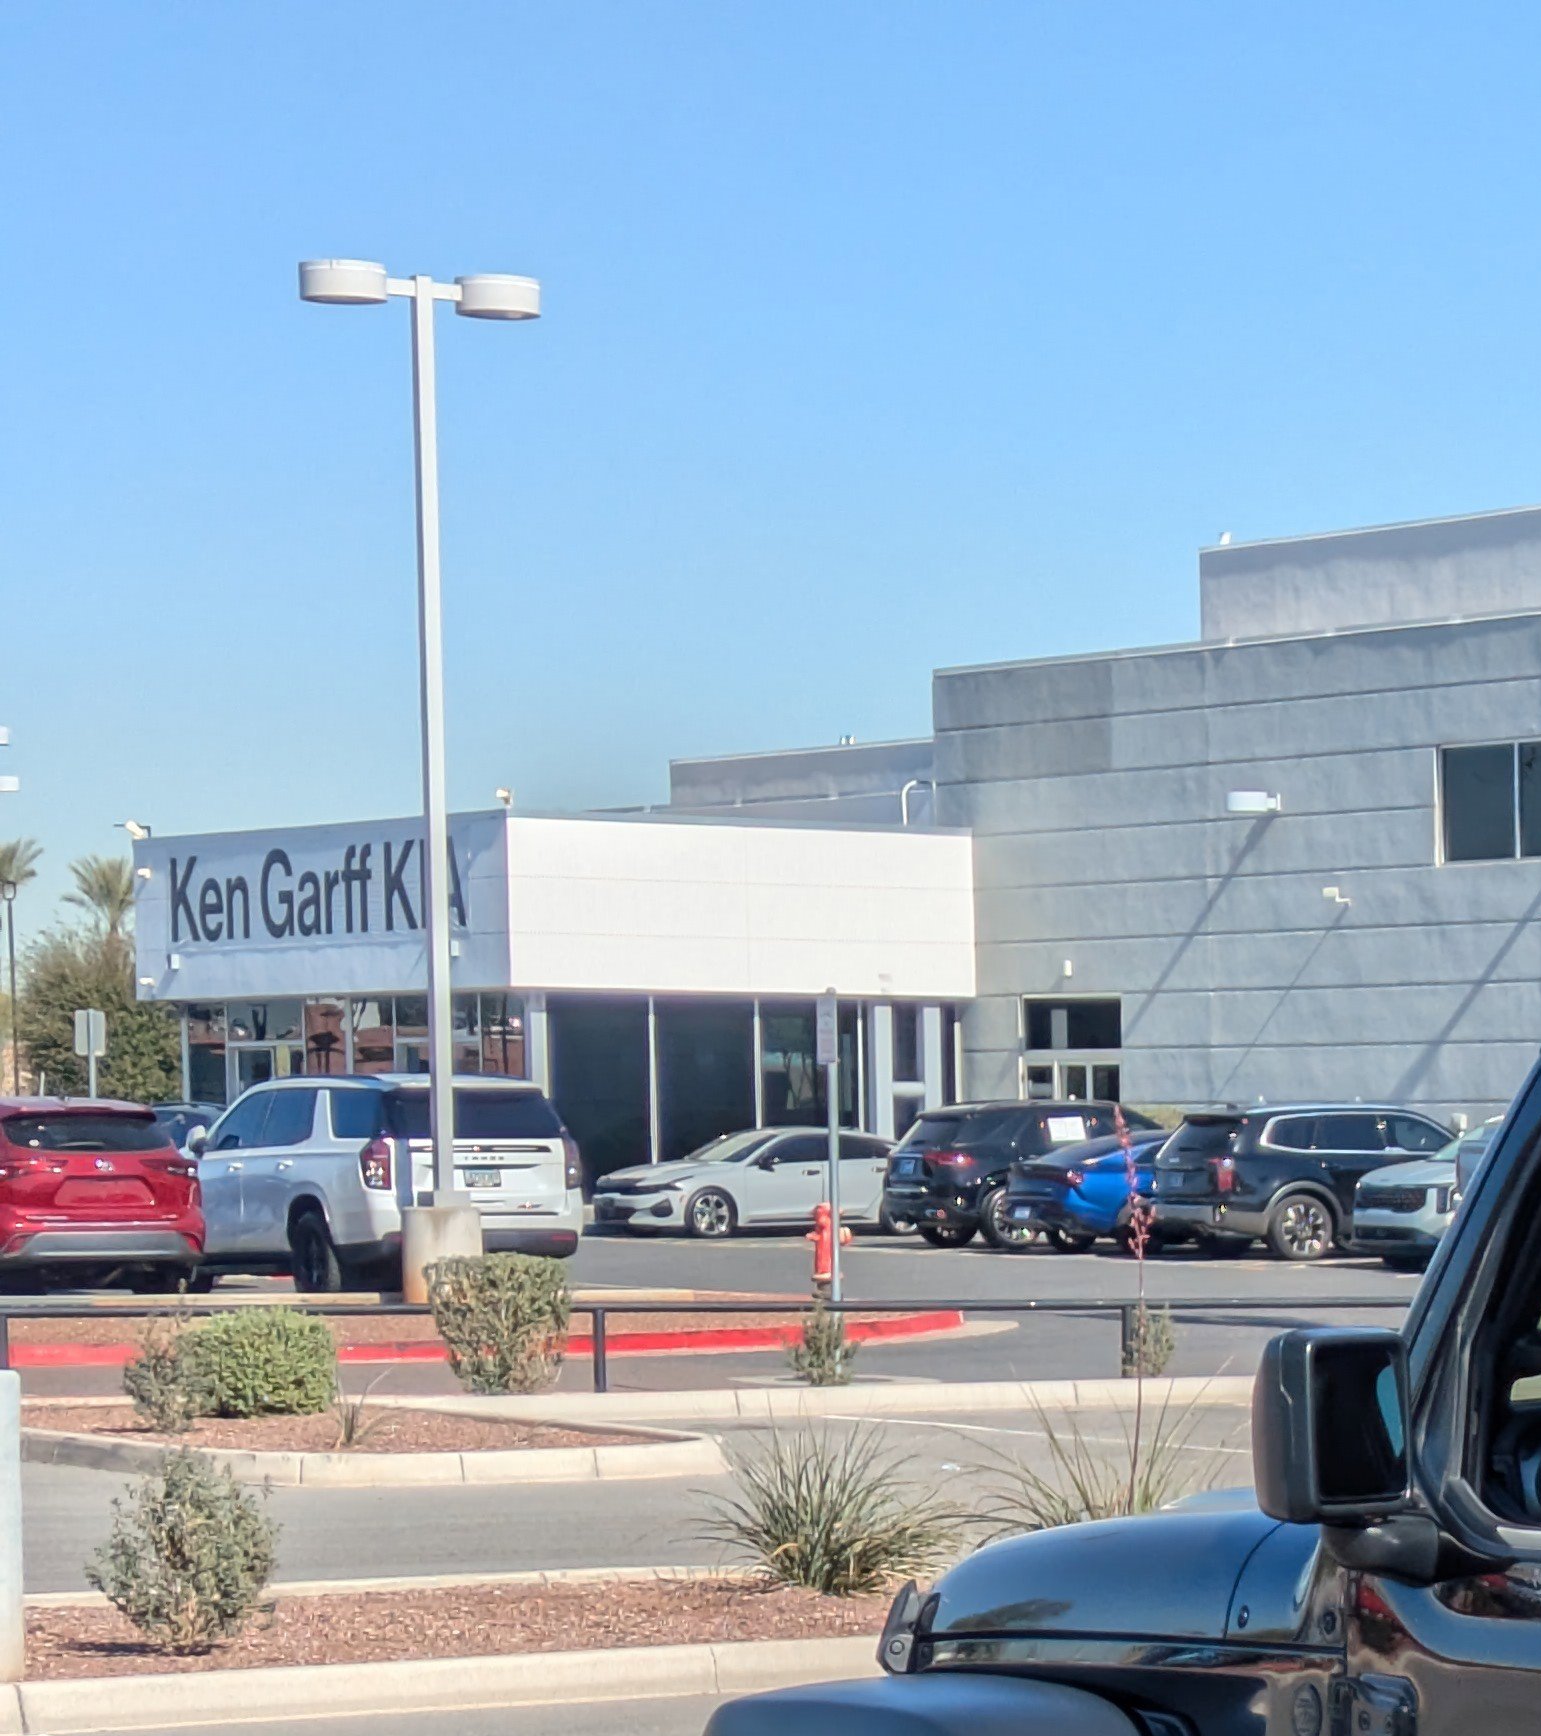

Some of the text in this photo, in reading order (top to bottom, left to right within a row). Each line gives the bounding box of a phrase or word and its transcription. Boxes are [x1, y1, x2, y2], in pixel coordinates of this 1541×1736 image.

[170, 836, 466, 942] Ken Garff KIA
